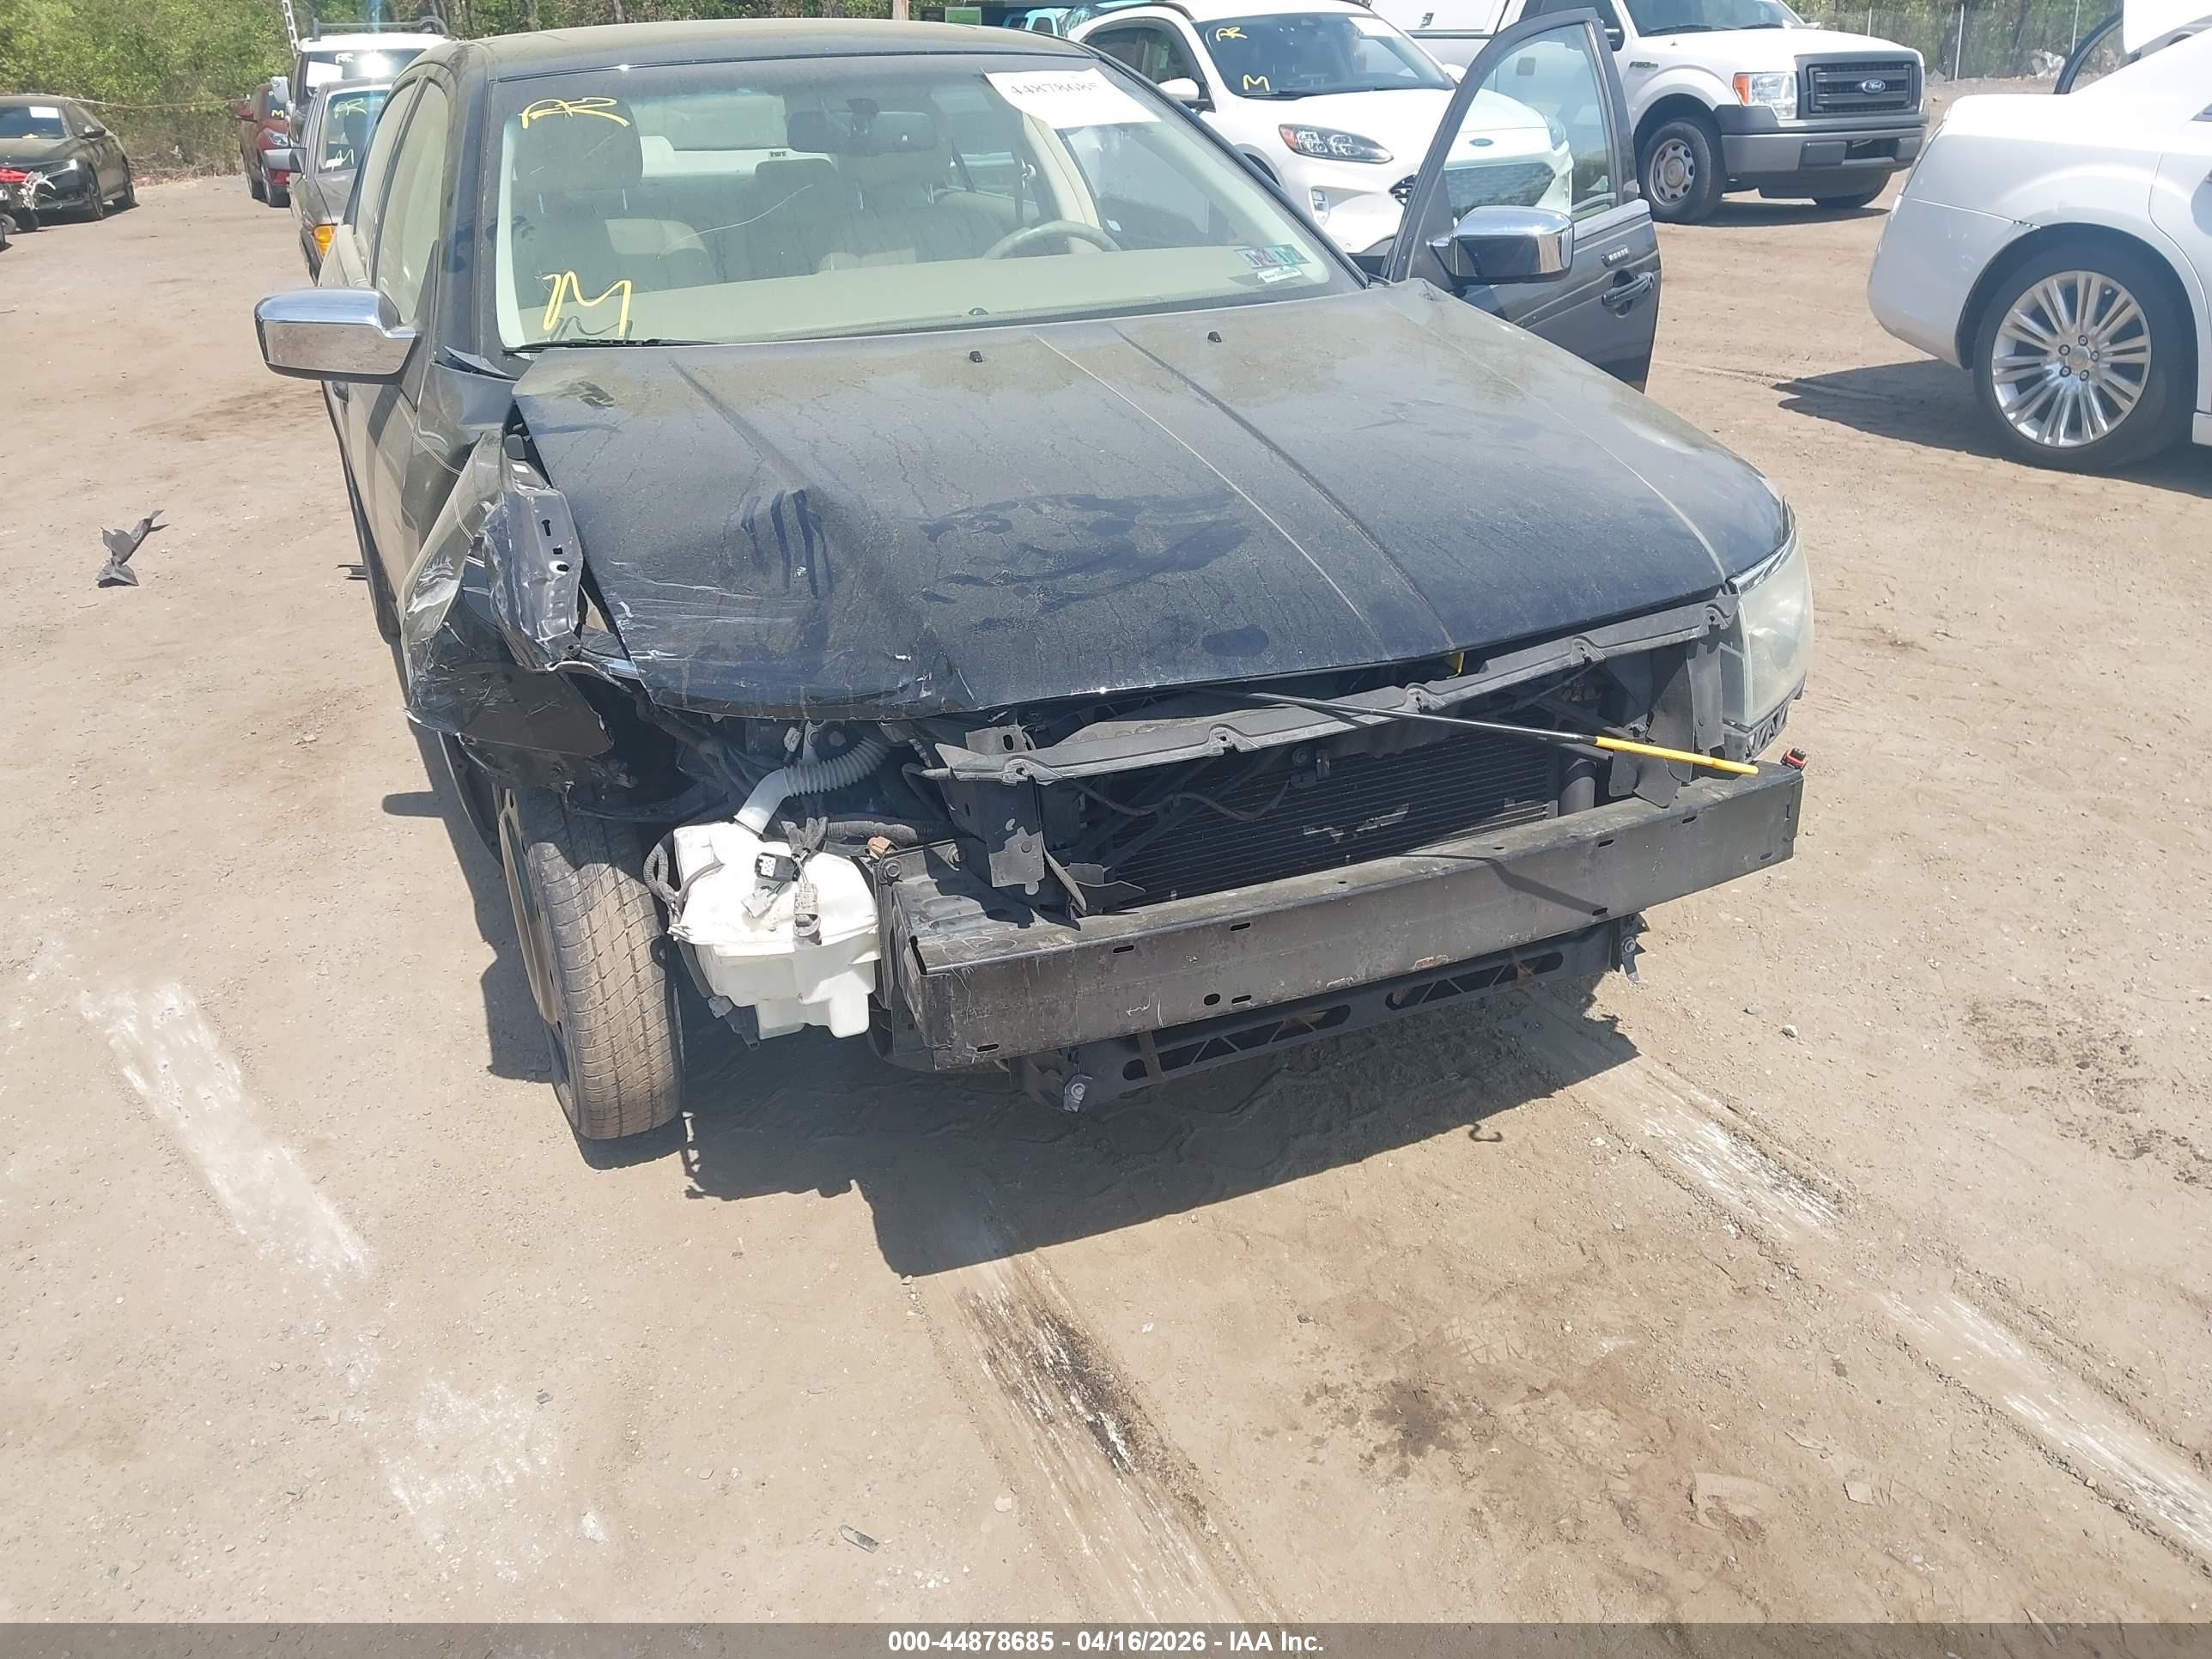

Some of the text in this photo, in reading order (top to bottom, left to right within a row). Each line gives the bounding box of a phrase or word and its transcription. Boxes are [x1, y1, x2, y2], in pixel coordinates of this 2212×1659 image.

[1243, 74, 1270, 91] M
[271, 109, 284, 118] M
[534, 270, 632, 337] M
